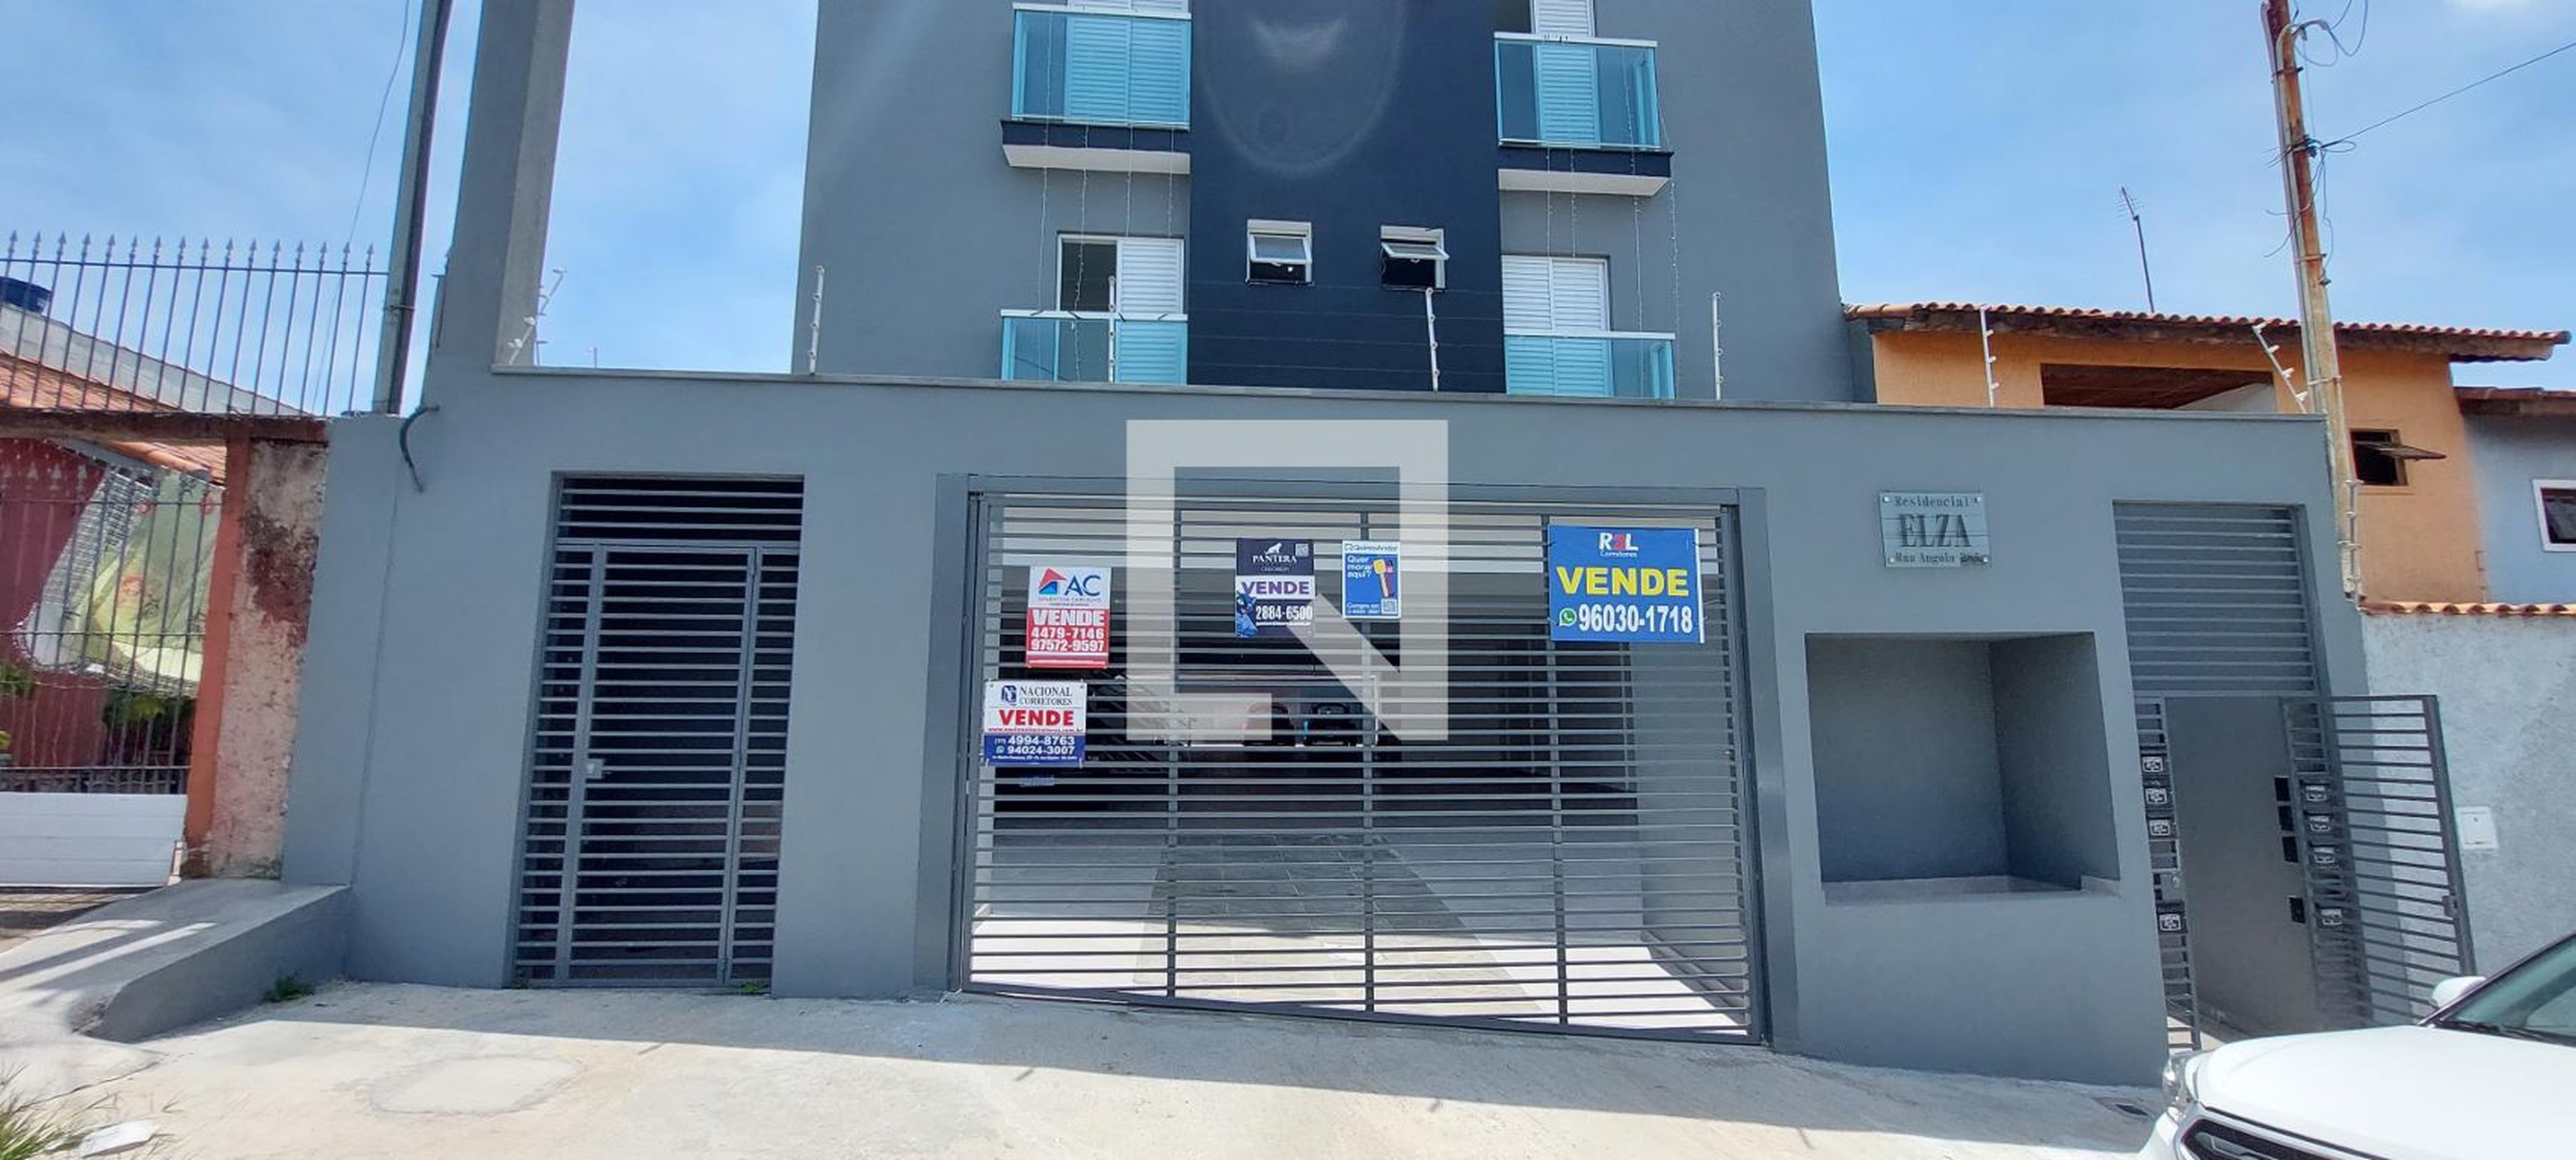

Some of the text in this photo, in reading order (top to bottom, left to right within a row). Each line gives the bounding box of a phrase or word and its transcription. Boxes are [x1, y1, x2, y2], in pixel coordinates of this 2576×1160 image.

[1895, 495, 1970, 507] Residencial
[1899, 514, 1972, 547] ELZA
[1252, 556, 1297, 564] PANTERA
[1064, 575, 1102, 596] AC
[1241, 581, 1309, 594] VENDE
[1556, 567, 1689, 596] VENDE
[1032, 609, 1105, 627] VENDE
[1256, 605, 1313, 621] 2884-6500
[1578, 604, 1693, 633] 96030-1718
[1031, 627, 1104, 639] 4479-7146
[1031, 639, 1104, 651] 97572-9597
[1020, 686, 1073, 696] NACIONAL
[1020, 698, 1073, 706] CORRETORES
[999, 709, 1074, 726] VENDE
[1008, 735, 1075, 745] 4994-8763
[1008, 746, 1075, 755] 94024-3007
